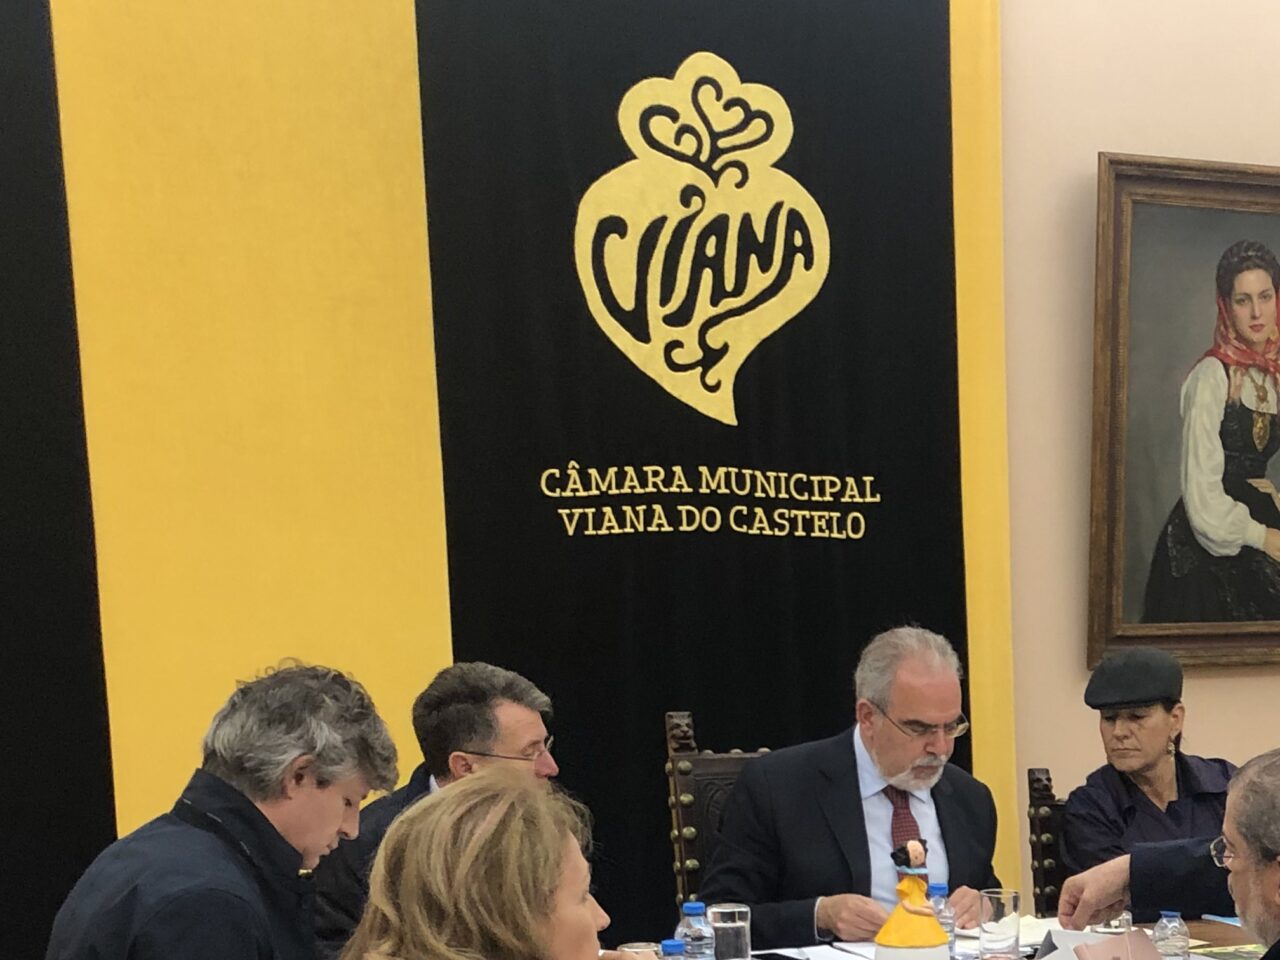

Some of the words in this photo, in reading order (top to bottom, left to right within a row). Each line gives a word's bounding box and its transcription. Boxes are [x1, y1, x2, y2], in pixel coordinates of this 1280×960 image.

[591, 184, 815, 344] VIANA
[540, 460, 693, 497] CÂMARA
[698, 465, 881, 503] MUNICIPAL
[558, 504, 674, 536] VIANA
[678, 506, 722, 533] DO
[729, 505, 866, 539] CASTELO
